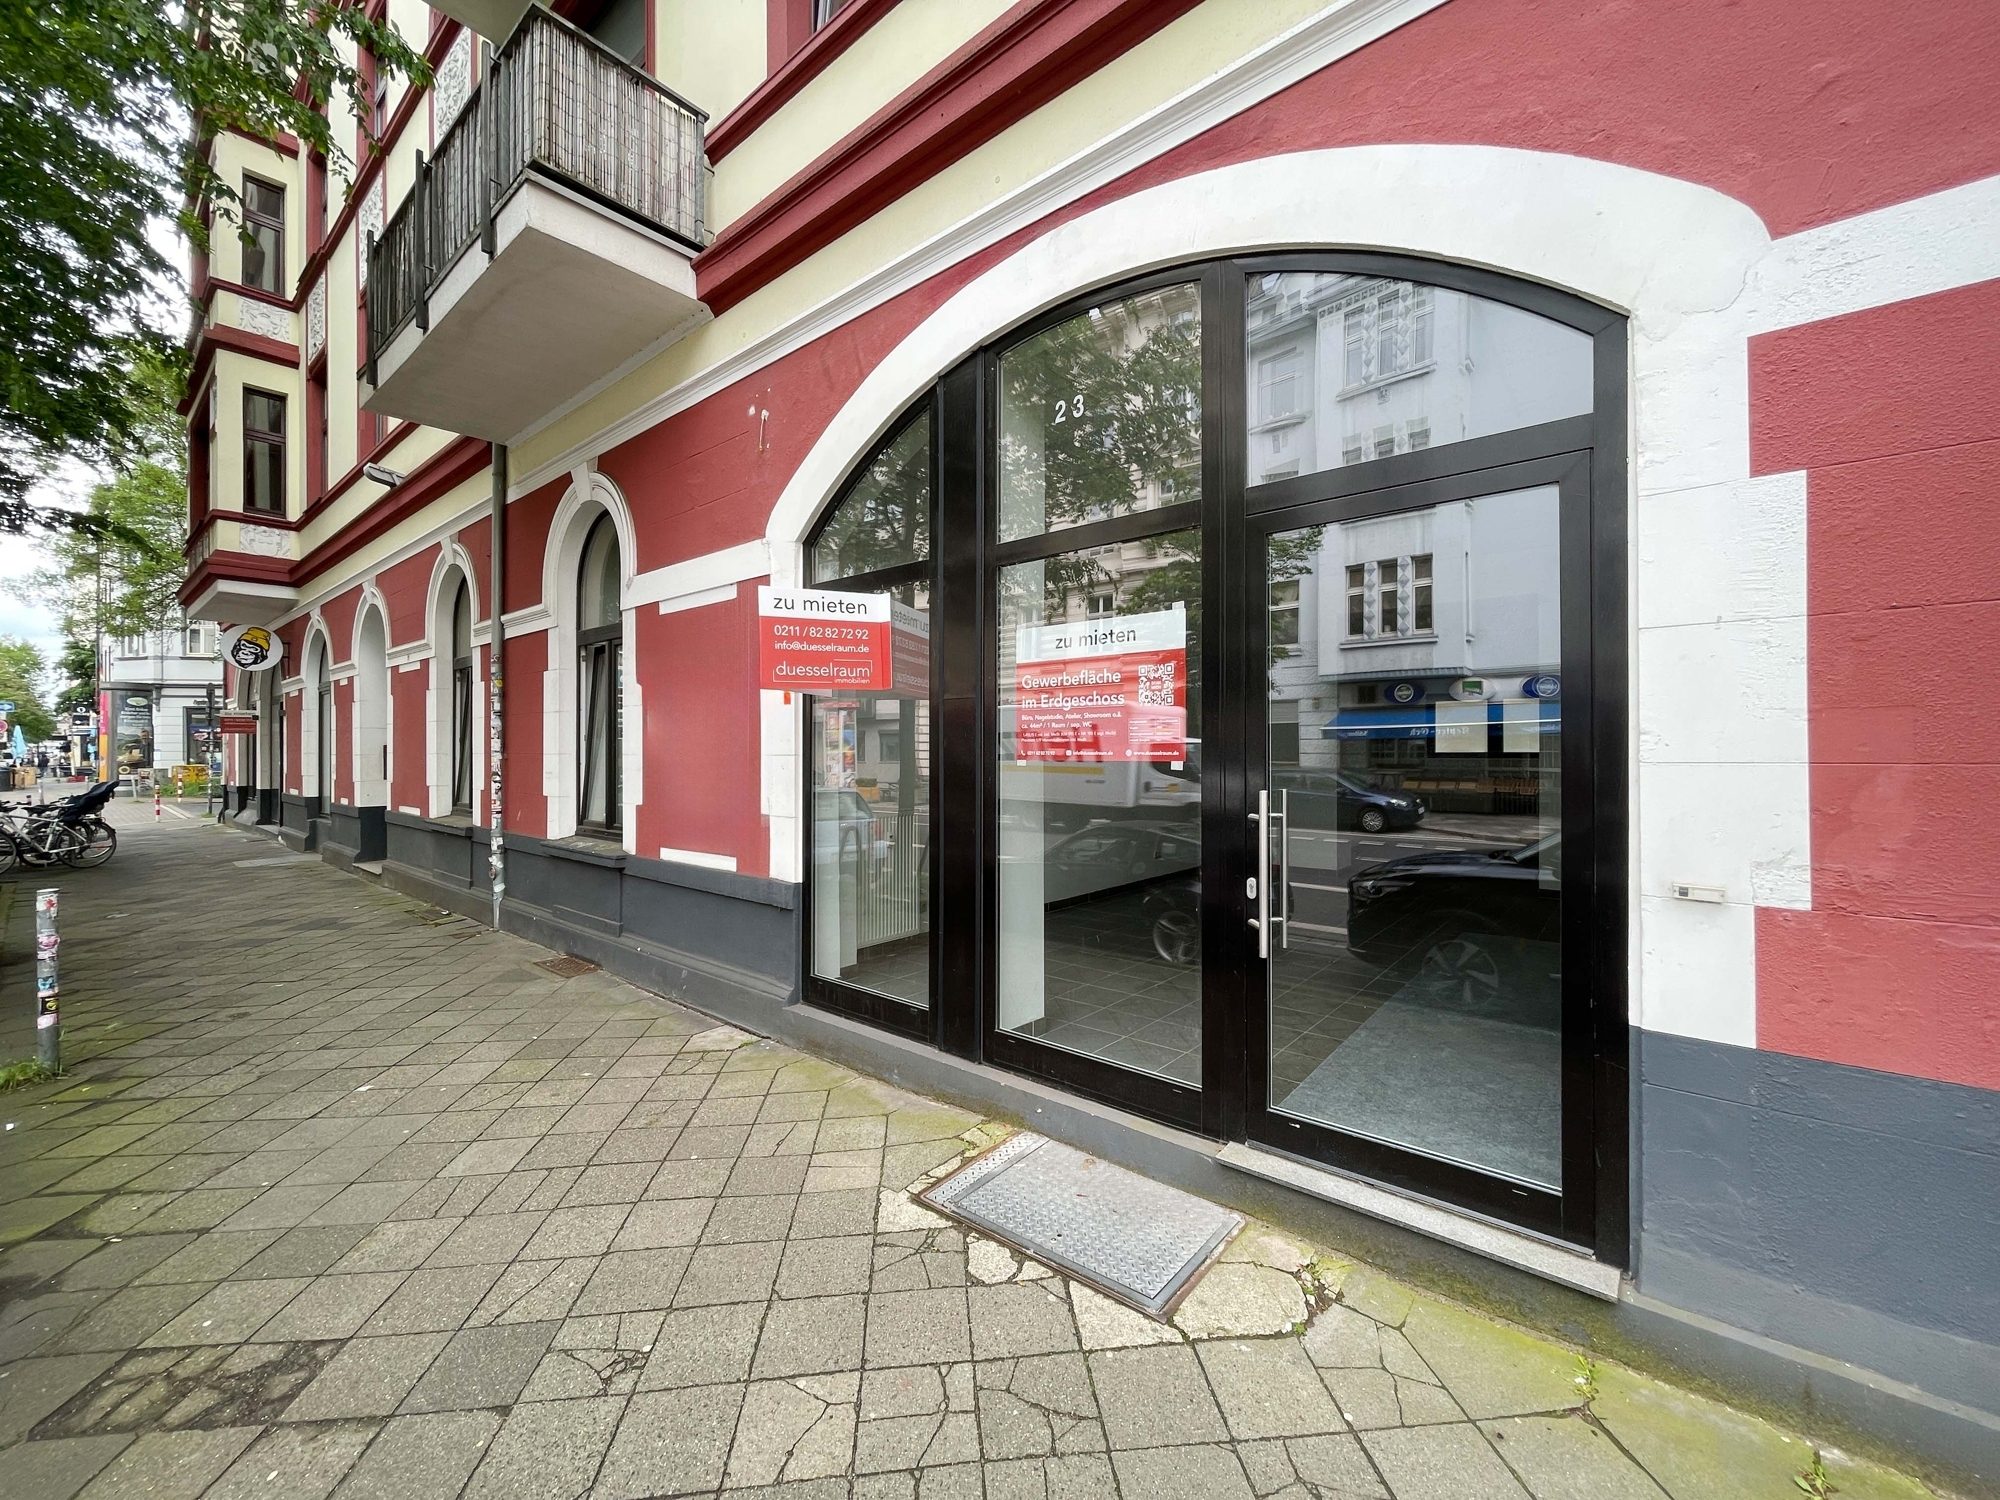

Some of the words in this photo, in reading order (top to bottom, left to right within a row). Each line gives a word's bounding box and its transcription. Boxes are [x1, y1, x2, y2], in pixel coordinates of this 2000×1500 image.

[1055, 394, 1084, 424] 23
[773, 597, 795, 610] zu
[803, 596, 868, 615] mieten
[774, 624, 800, 637] 0211
[809, 626, 823, 638] 82
[825, 627, 838, 639] 82
[840, 628, 853, 639] 72
[855, 629, 869, 640] 92
[1055, 637, 1072, 649] zu
[1079, 629, 1136, 647] mieten
[774, 641, 870, 654] info@duesselraum.de
[776, 661, 870, 678] duesselraum
[1022, 669, 1121, 689] Gewerbefläche
[1022, 696, 1037, 708] im
[1041, 692, 1125, 710] Erdgeschoss
